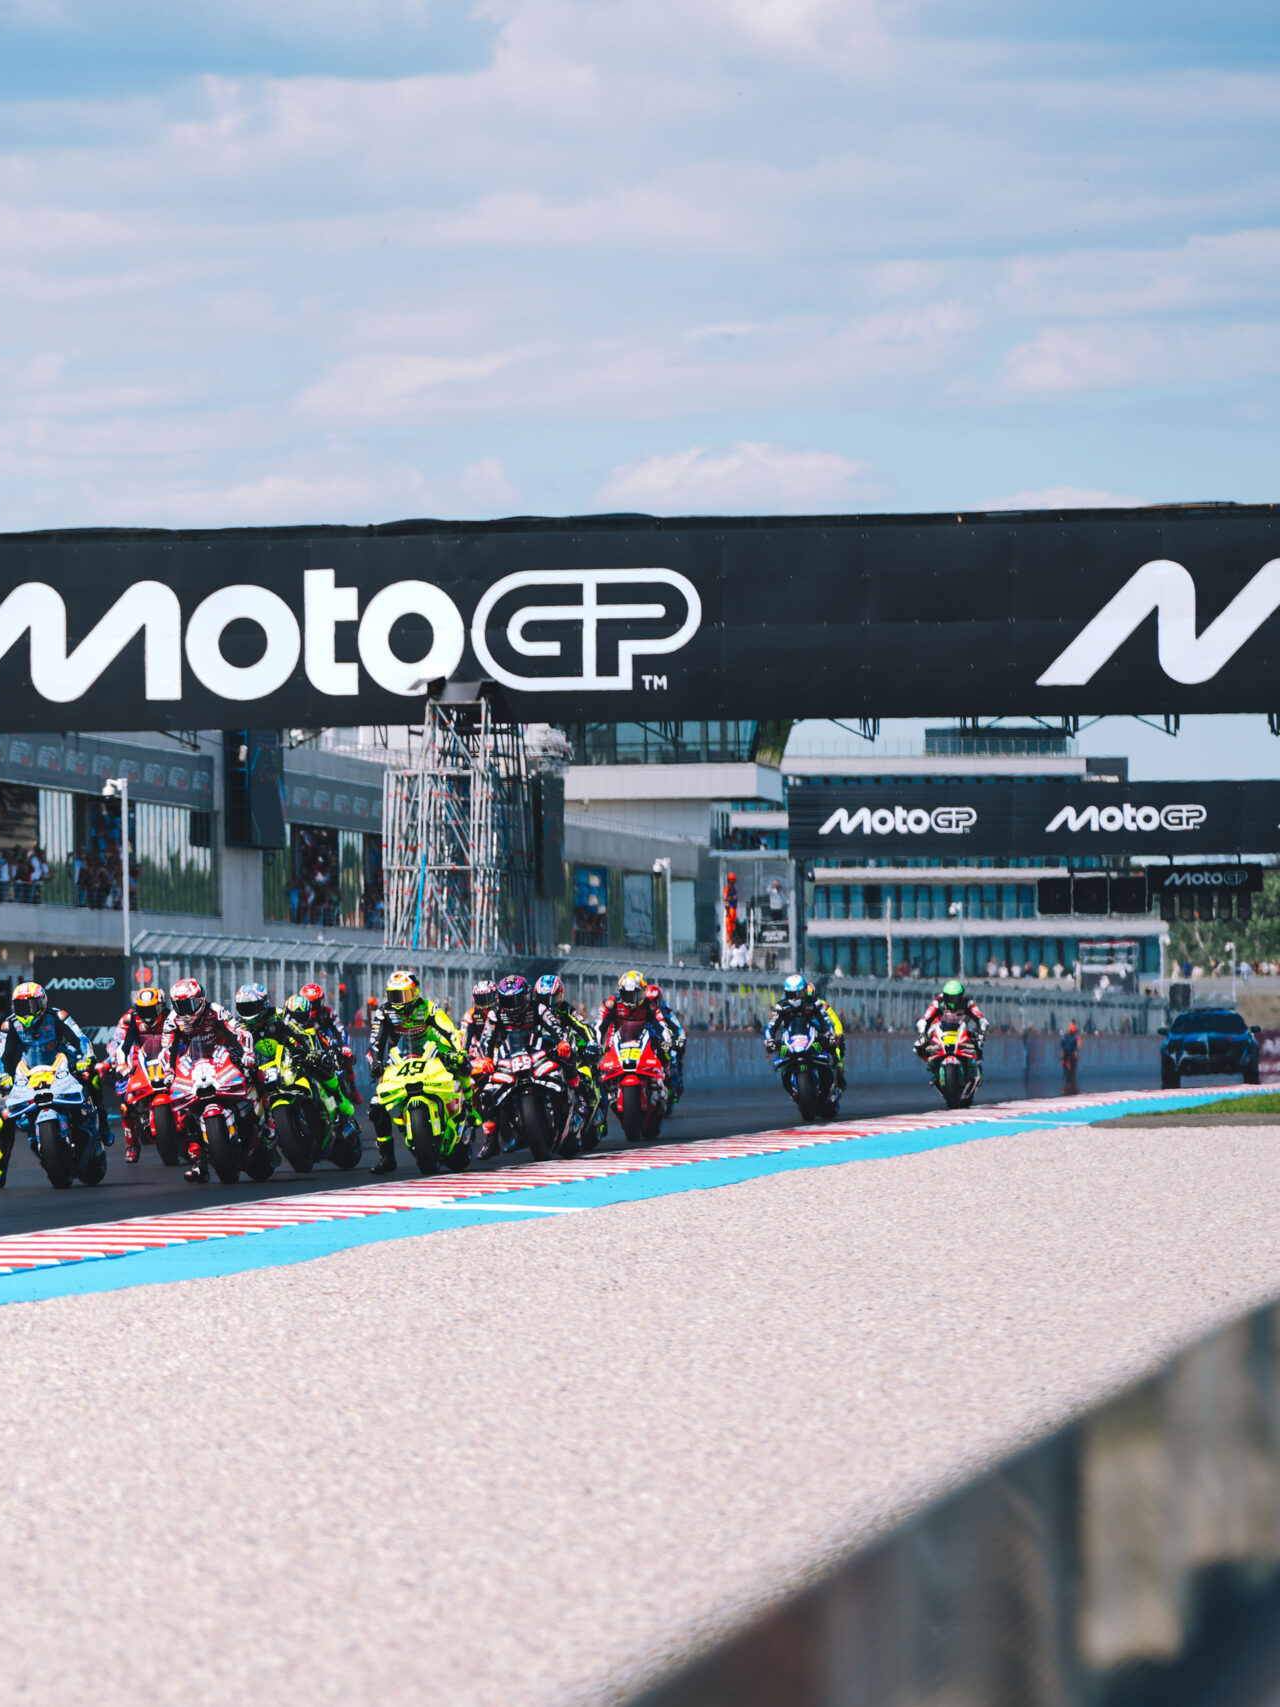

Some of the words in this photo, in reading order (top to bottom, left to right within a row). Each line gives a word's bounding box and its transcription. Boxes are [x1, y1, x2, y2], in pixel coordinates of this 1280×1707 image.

[818, 805, 978, 835] MotoGP
[1045, 803, 1208, 833] MotoGP
[1163, 871, 1249, 886] MotoGP
[45, 976, 116, 991] MotoGP
[619, 1048, 641, 1062] 36
[396, 1060, 426, 1077] 49
